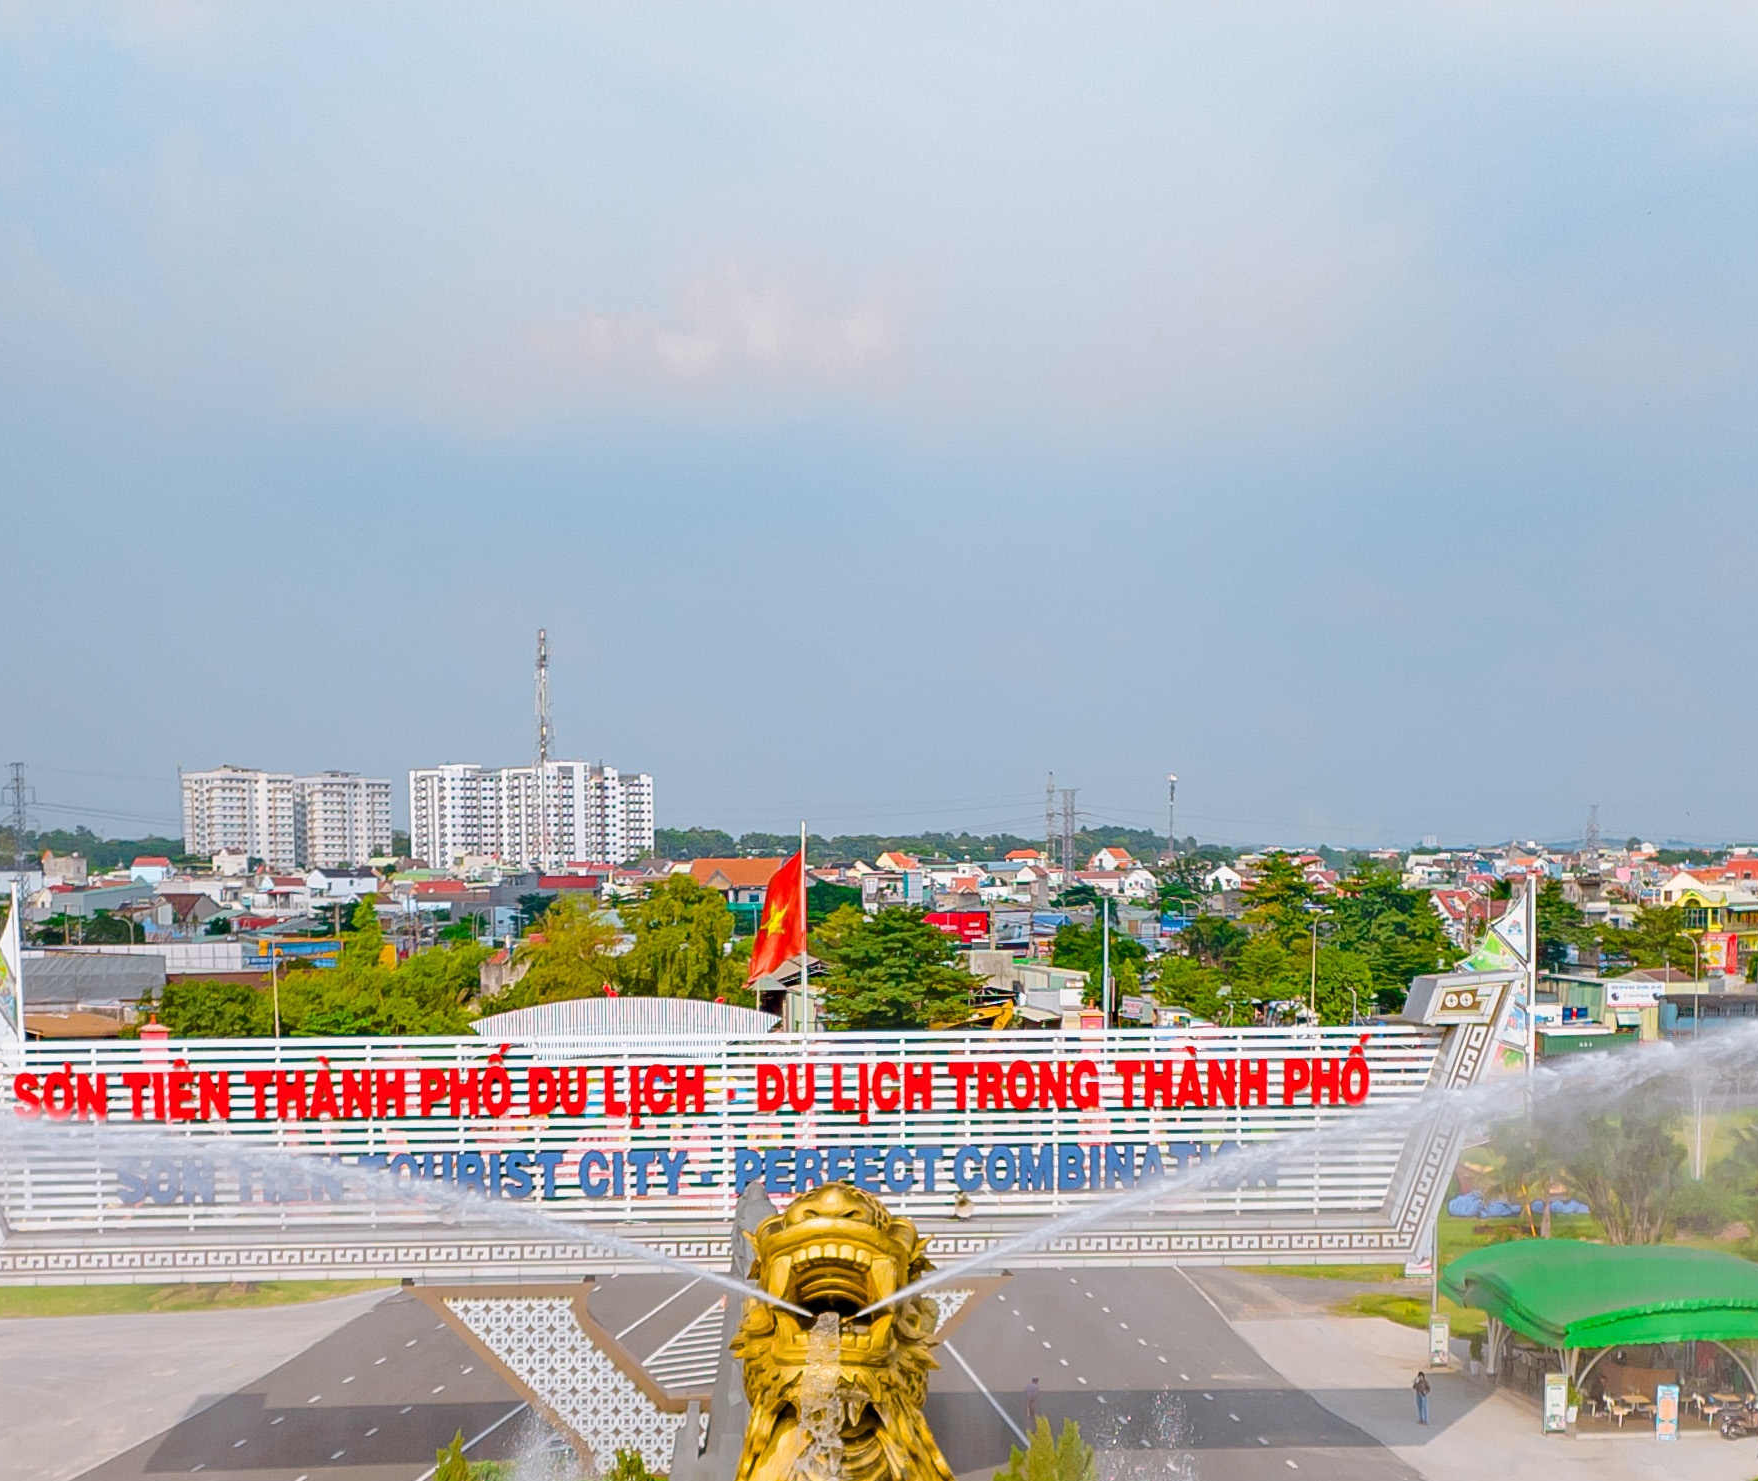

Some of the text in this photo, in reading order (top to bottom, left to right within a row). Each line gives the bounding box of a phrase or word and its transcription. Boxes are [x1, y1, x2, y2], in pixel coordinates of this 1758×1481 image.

[12, 1033, 1371, 1128] SƠN TIÊN THÀNH PHỐ DU LỊCH DU LỊCH TRONG THÀNH PHỐ
[358, 1151, 564, 1199] TOURIST
[578, 1150, 688, 1198] CITY
[735, 1146, 943, 1194] PERFECT
[953, 1140, 1278, 1193] COMBINATION
